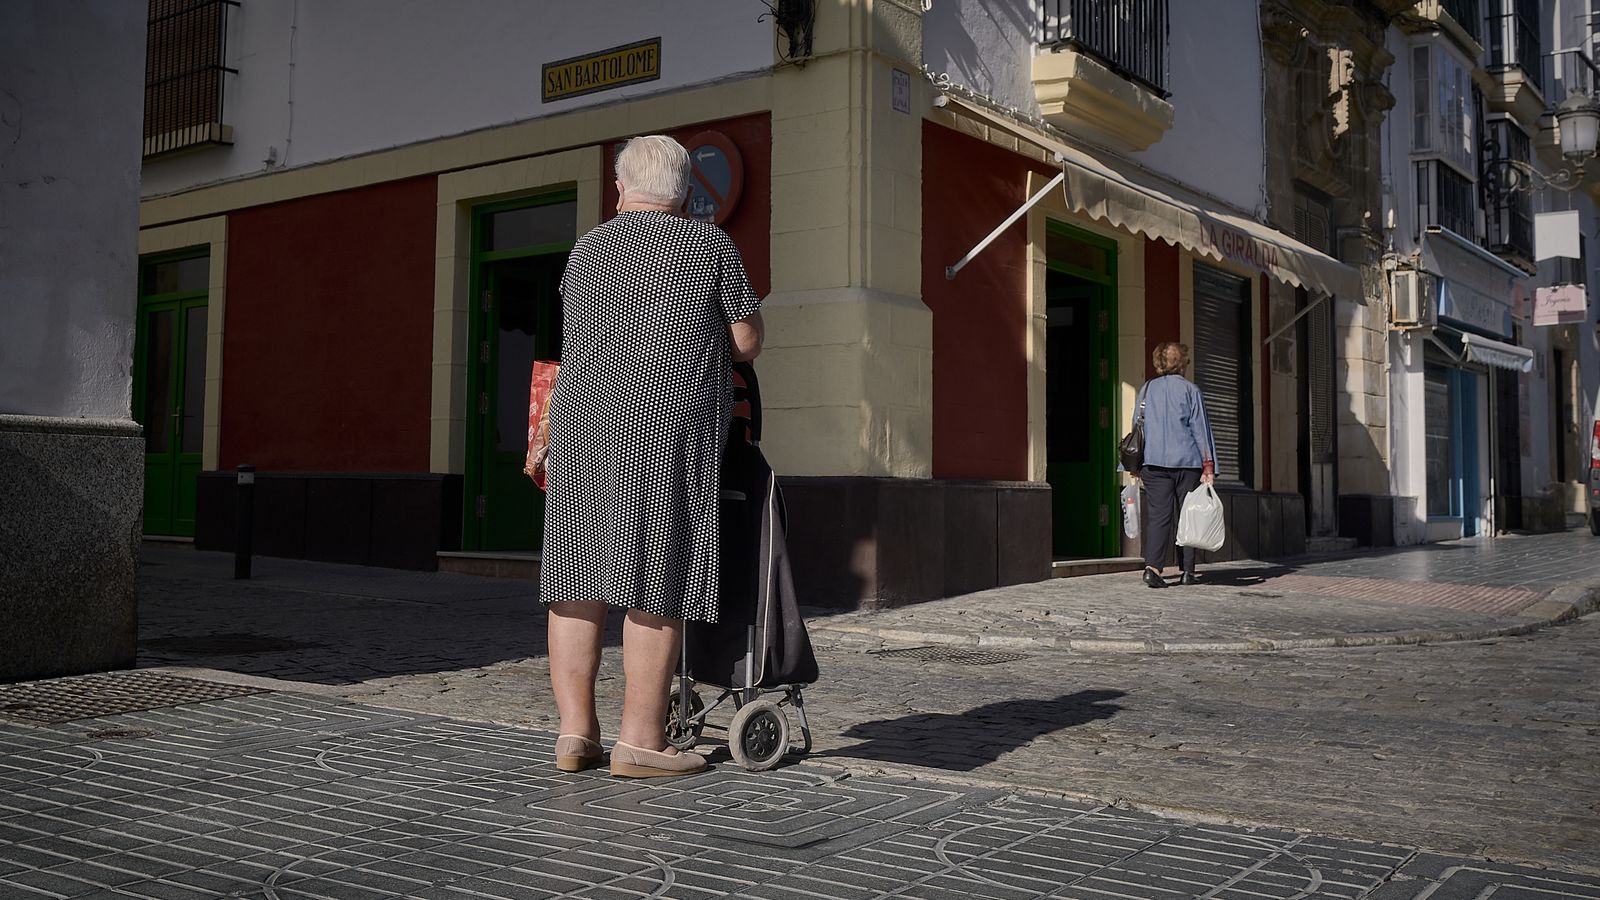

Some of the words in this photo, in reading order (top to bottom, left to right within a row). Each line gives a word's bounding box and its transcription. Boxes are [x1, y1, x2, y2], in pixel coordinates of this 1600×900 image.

[547, 66, 572, 93] SAN
[575, 48, 656, 88] BARTOLOME
[1200, 221, 1219, 251] LA
[1222, 229, 1280, 272] GIRALDA
